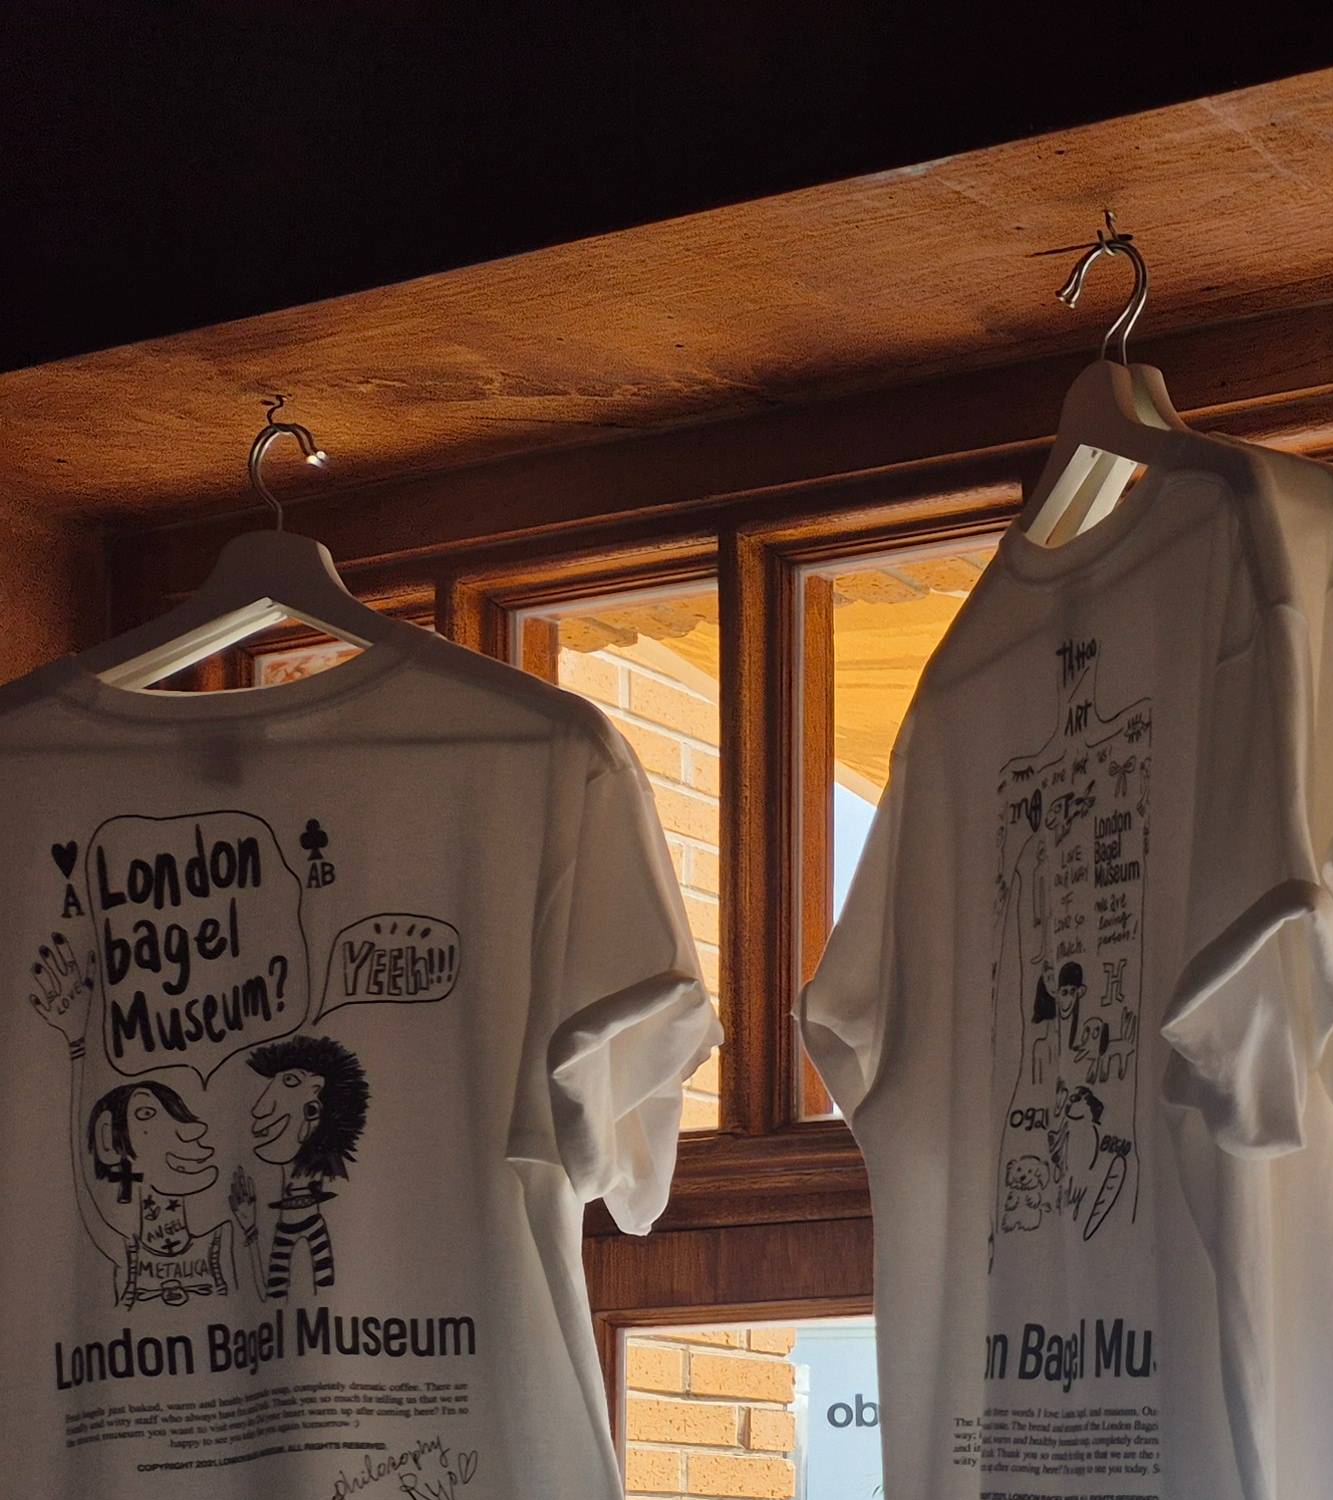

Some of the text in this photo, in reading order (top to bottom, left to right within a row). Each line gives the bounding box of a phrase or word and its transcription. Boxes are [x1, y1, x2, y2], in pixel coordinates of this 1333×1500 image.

[1095, 810, 1132, 839] London
[97, 824, 261, 910] London
[306, 862, 336, 888] AB
[1095, 860, 1140, 888] Museum
[104, 897, 240, 995] bagel
[111, 955, 288, 1058] Museum?
[55, 1305, 477, 1389] London Bagel Museum
